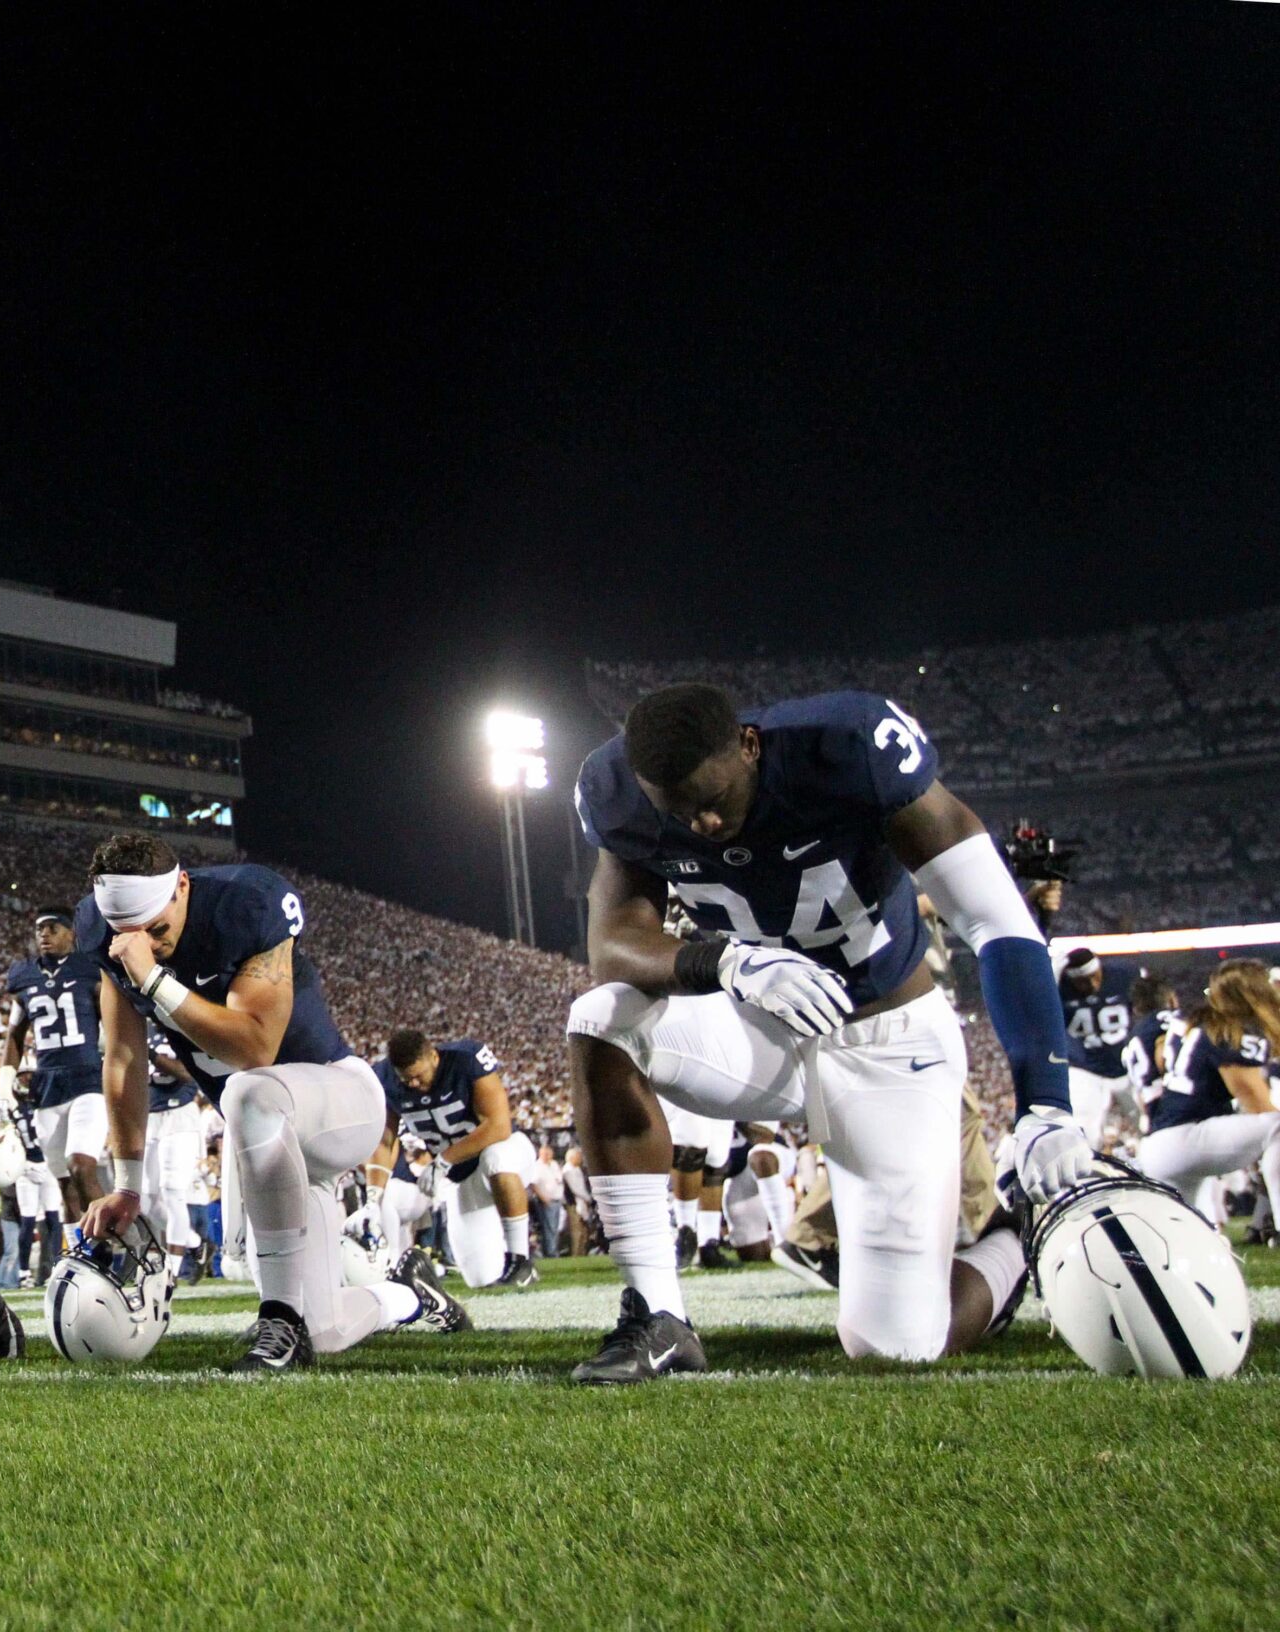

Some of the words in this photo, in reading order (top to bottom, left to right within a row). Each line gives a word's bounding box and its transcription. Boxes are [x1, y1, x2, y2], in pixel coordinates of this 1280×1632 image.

[281, 892, 304, 936] 9
[28, 991, 86, 1051] 21
[1067, 1005, 1129, 1050] 49
[1240, 1034, 1269, 1063] 51
[401, 1100, 478, 1155] 55
